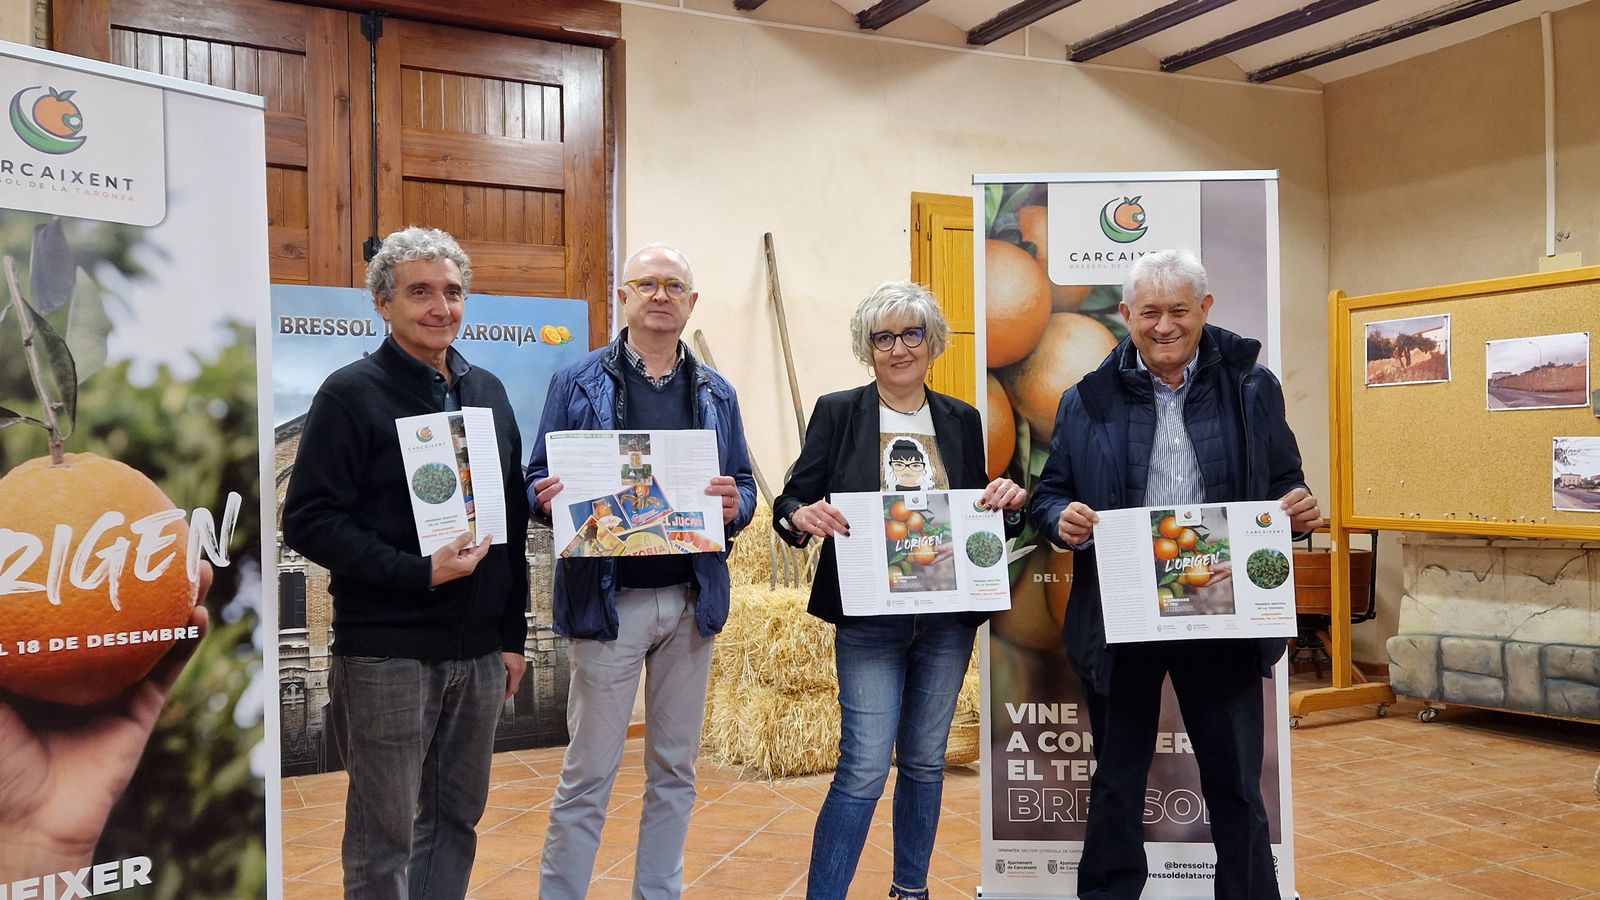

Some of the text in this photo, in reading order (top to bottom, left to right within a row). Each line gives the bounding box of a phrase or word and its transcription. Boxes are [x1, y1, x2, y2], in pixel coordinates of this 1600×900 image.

[29, 181, 45, 190] DE
[52, 184, 68, 193] LA
[75, 187, 135, 202] TARONJA
[278, 315, 377, 337] BRESSOL
[456, 323, 537, 347] ARONJA
[895, 533, 943, 553] L'ORIGEN
[1165, 551, 1220, 573] L'ORIGEN
[1033, 573, 1060, 583] DEL
[17, 640, 40, 655] 18
[49, 637, 79, 652] DE
[87, 626, 199, 649] DESEMBRE
[1004, 702, 1078, 724] VINE
[1005, 730, 1030, 752] A
[1007, 759, 1044, 781] EL
[1164, 861, 1215, 870] @bressolta
[0, 856, 152, 900] EIXER
